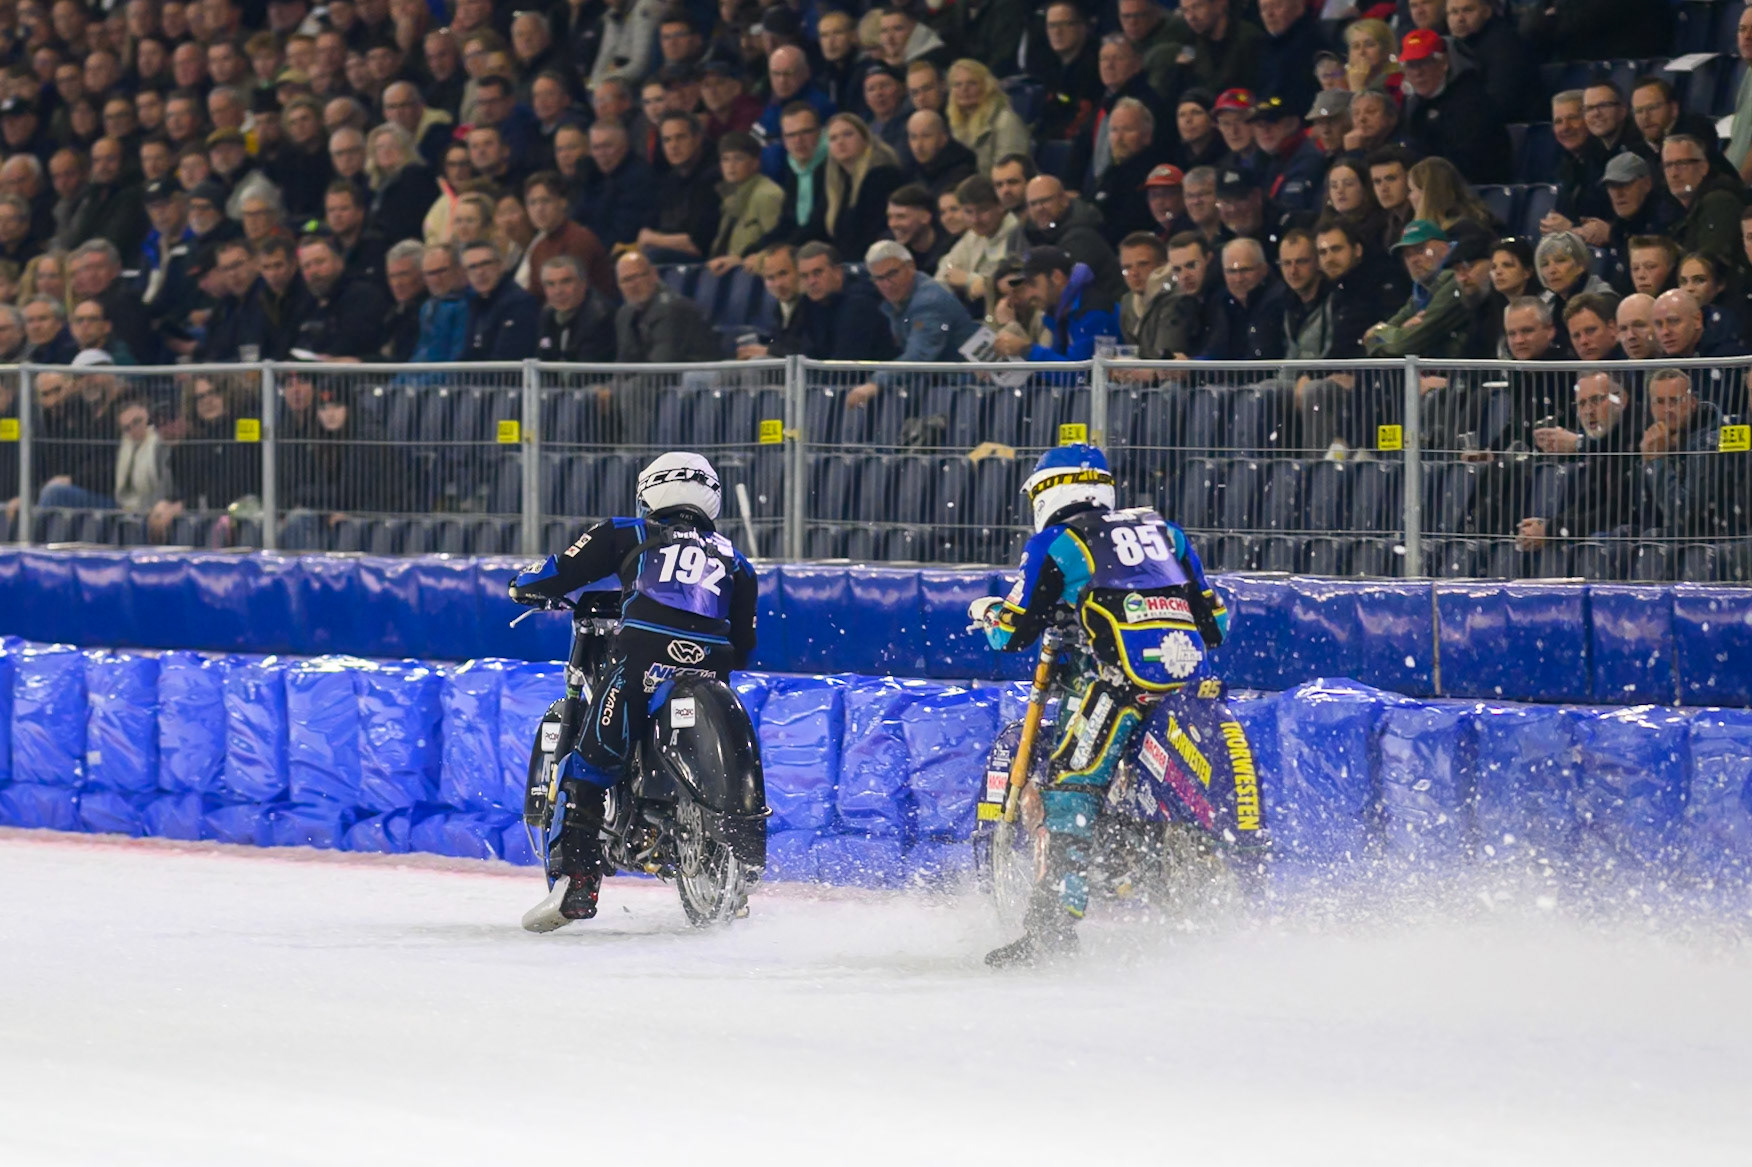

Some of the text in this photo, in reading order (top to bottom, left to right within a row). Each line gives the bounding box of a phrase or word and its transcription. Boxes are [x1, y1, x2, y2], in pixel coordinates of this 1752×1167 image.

[1110, 525, 1169, 567] 85
[658, 544, 726, 596] 192
[601, 687, 620, 726] WACO
[1220, 722, 1260, 830] THORWESTEN
